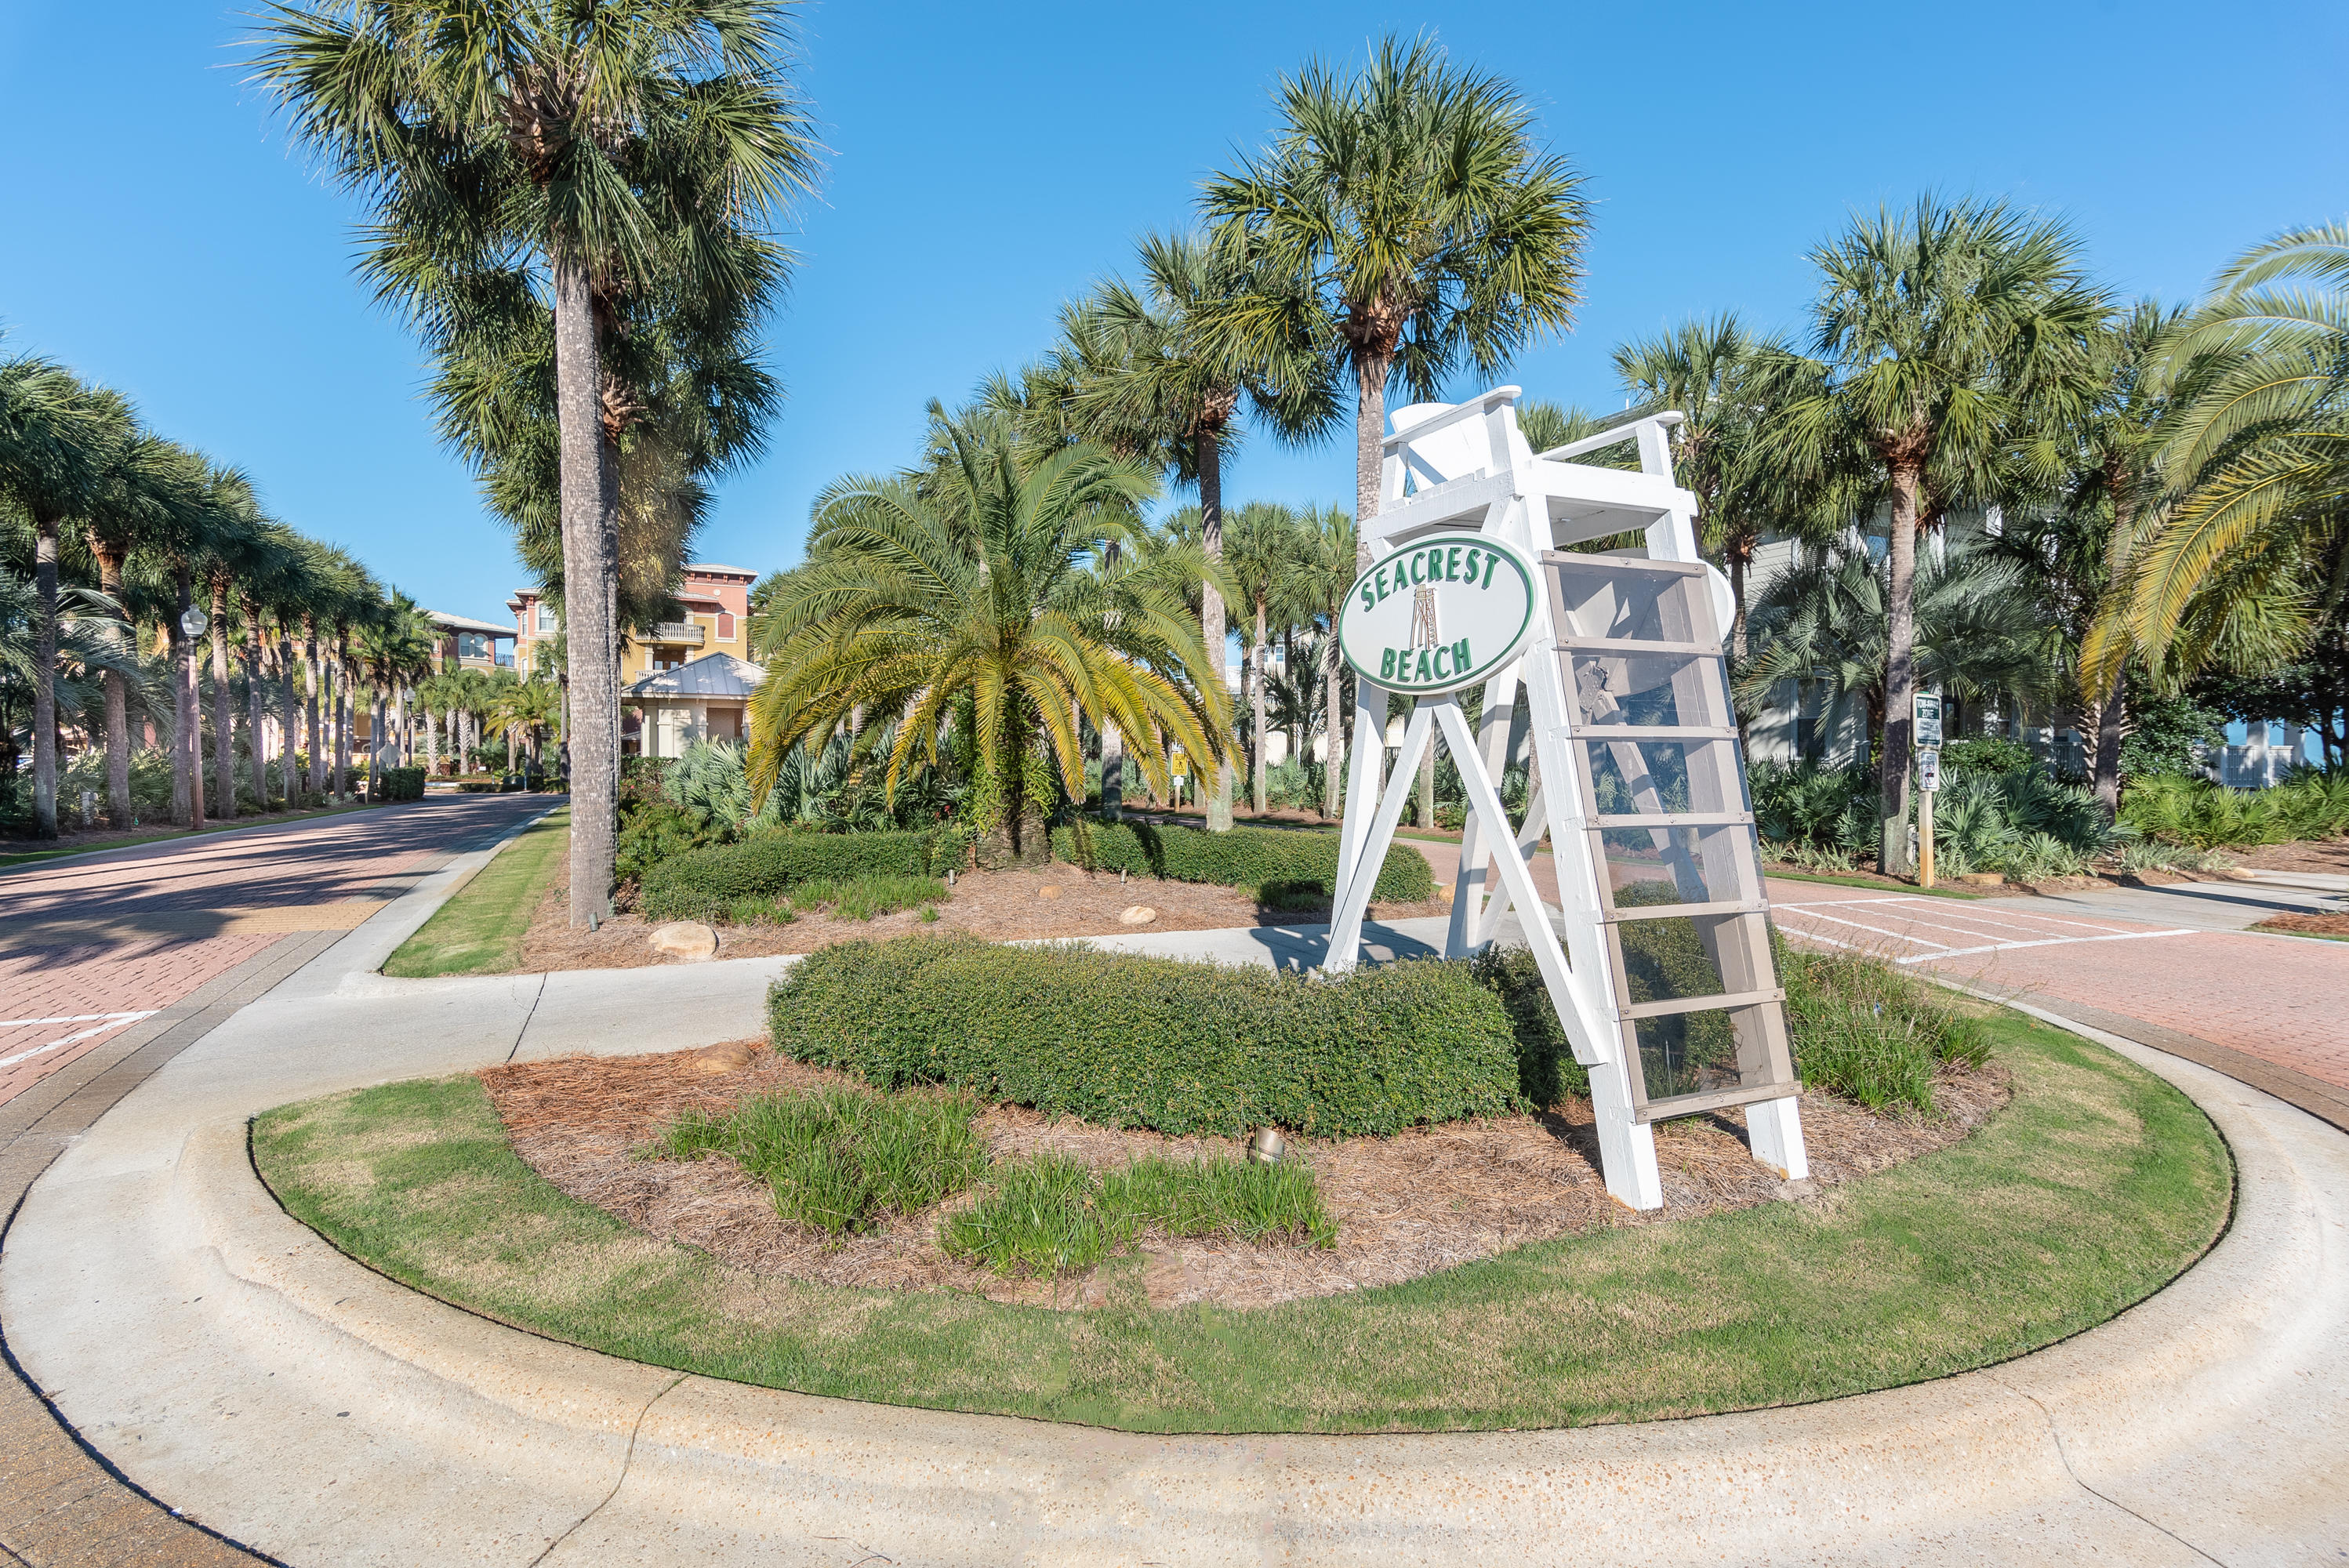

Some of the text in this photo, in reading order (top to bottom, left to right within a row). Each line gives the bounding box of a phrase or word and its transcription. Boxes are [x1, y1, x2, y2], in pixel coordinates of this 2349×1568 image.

[1360, 547, 1501, 612] SEACREST
[1380, 637, 1472, 682] BEACH
[1917, 699, 1939, 710] TOW-AWAY
[1922, 709, 1934, 718] ZONE
